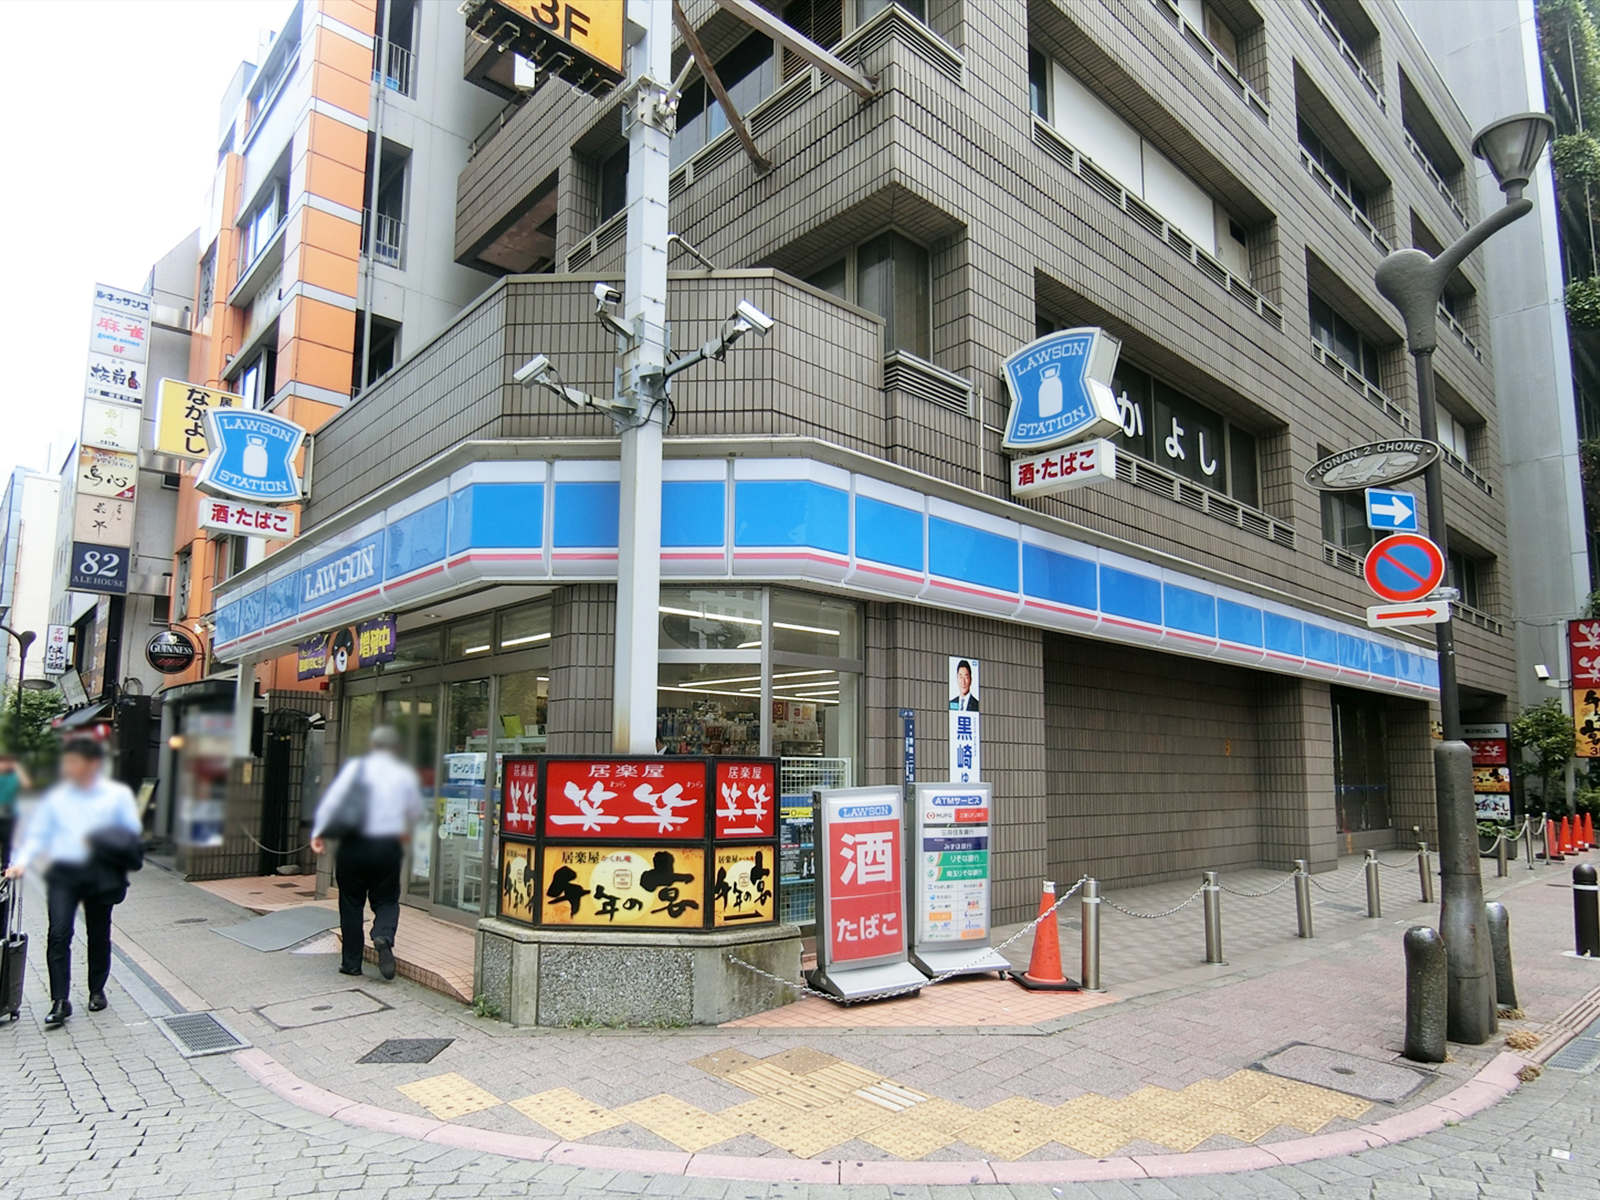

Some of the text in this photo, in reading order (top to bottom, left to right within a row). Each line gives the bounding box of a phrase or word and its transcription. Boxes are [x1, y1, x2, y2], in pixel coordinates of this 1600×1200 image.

[531, 0, 590, 42] 3F
[96, 290, 149, 311] ルネッサンス
[96, 317, 145, 341] 麻雀
[113, 345, 126, 353] 6F
[1015, 342, 1086, 376] LAWSON
[184, 388, 211, 454] なかよし
[222, 418, 292, 443] LAWSON
[1017, 405, 1086, 436] STATION
[1117, 391, 1217, 476] かよし
[1018, 449, 1095, 486] 酒・たばこ
[1316, 442, 1424, 476] KONAN 2 CHOME
[219, 470, 288, 492] STATION
[211, 503, 287, 532] 酒・たばこ
[80, 551, 120, 577] 82
[304, 544, 376, 602] LAWSON
[72, 576, 125, 588] ALE HOUSE
[150, 643, 193, 655] GUINNESS
[588, 765, 665, 778] 居楽屋
[727, 766, 762, 779] 居楽屋
[507, 780, 537, 830] 笑笑
[550, 780, 698, 833] 笑笑
[716, 782, 771, 822] 笑笑
[843, 806, 889, 817] LAWSON
[934, 796, 980, 805] ATMサービス
[561, 852, 600, 864] 居楽屋
[840, 831, 893, 885] 酒
[950, 854, 979, 863] りそな銀行
[547, 851, 699, 921] 千年の宴
[714, 851, 772, 912] 千年の宴
[837, 913, 898, 942] たばこ
